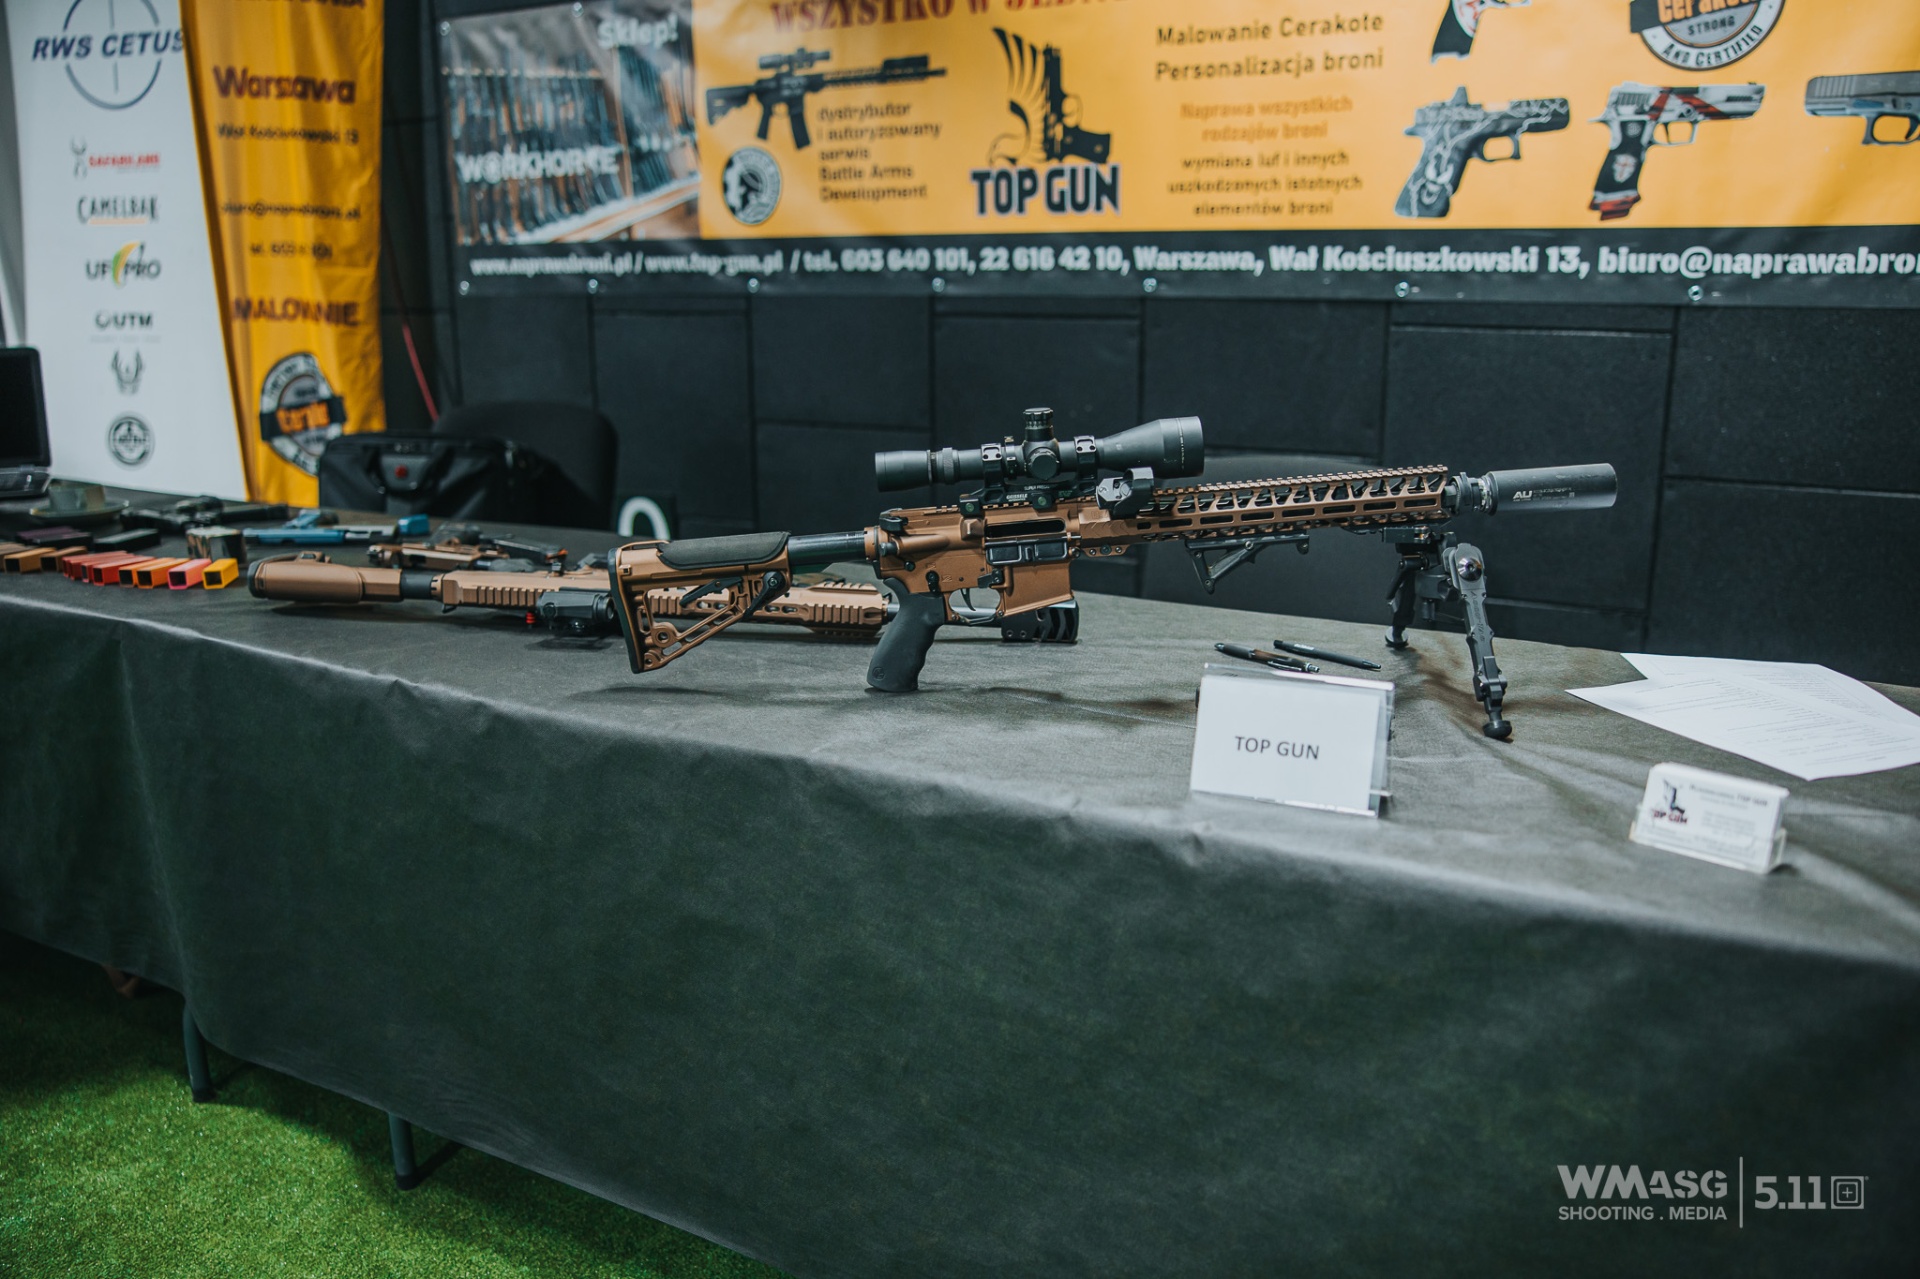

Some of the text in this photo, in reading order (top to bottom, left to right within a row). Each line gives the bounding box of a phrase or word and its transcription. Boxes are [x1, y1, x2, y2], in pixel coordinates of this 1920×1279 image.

[1156, 14, 1383, 45] Malowanie Cerakote
[1688, 16, 1735, 36] STRONG
[31, 30, 184, 61] RWS CETUS
[1662, 25, 1763, 66] AND CERTIFIED
[1156, 47, 1384, 80] Personalizacja broni
[1180, 96, 1353, 121] Naprawa wszystkich
[1282, 121, 1329, 139] broni
[971, 164, 1120, 215] TOP GUN
[803, 249, 838, 272] tel.
[840, 248, 884, 272] 603
[887, 248, 930, 272] 640
[934, 247, 976, 276] 101,
[979, 246, 1009, 271] 22
[1058, 246, 1091, 271] 42
[1095, 245, 1130, 276] 10,
[1133, 245, 1264, 277] Warszawa,
[1322, 245, 1538, 273] Kościuszkowski
[1545, 246, 1590, 279] 13,
[1599, 246, 1920, 279] biuro@naprawabro
[1234, 735, 1320, 760] TOP GUN
